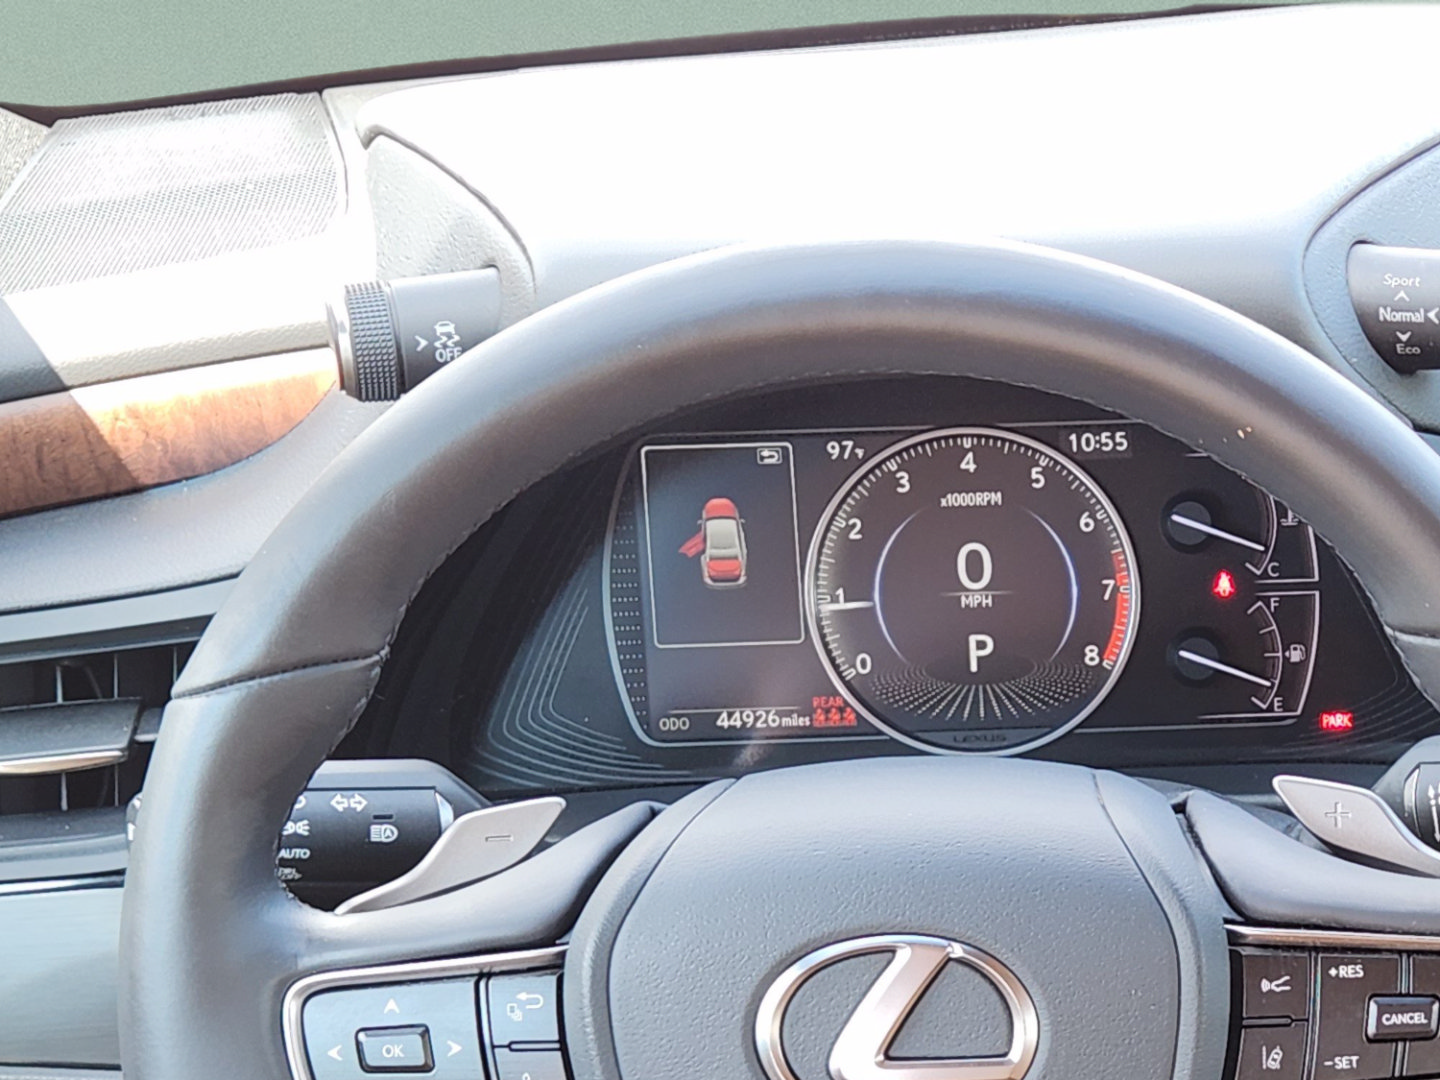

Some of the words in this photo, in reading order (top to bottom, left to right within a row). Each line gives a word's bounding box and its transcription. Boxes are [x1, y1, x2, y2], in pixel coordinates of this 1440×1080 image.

[1383, 273, 1421, 288] Sport
[1378, 307, 1425, 323] Normal
[1396, 343, 1421, 355] Eco
[1069, 432, 1128, 452] 10:55
[960, 452, 977, 473] 4
[895, 472, 911, 493] 3
[1031, 467, 1045, 489] 5
[940, 491, 1002, 508] x1000RPM
[848, 518, 863, 541] 2
[1079, 515, 1095, 532] 6
[956, 542, 993, 590] 0
[1267, 562, 1280, 577] C
[835, 588, 844, 604] 1
[1101, 580, 1115, 600] 7
[960, 595, 992, 609] MPH
[1270, 597, 1280, 613] F
[968, 634, 994, 673] P
[1084, 645, 1100, 666] 8
[855, 653, 872, 675] 0
[812, 697, 844, 708] REAR
[1273, 697, 1283, 712] E
[659, 717, 690, 731] ODO
[715, 709, 780, 729] 44926
[781, 714, 811, 728] miles
[1321, 712, 1352, 728] PARK
[279, 848, 311, 859] AUTO
[1382, 1012, 1428, 1025] CANCEL
[382, 1045, 404, 1058] OK
